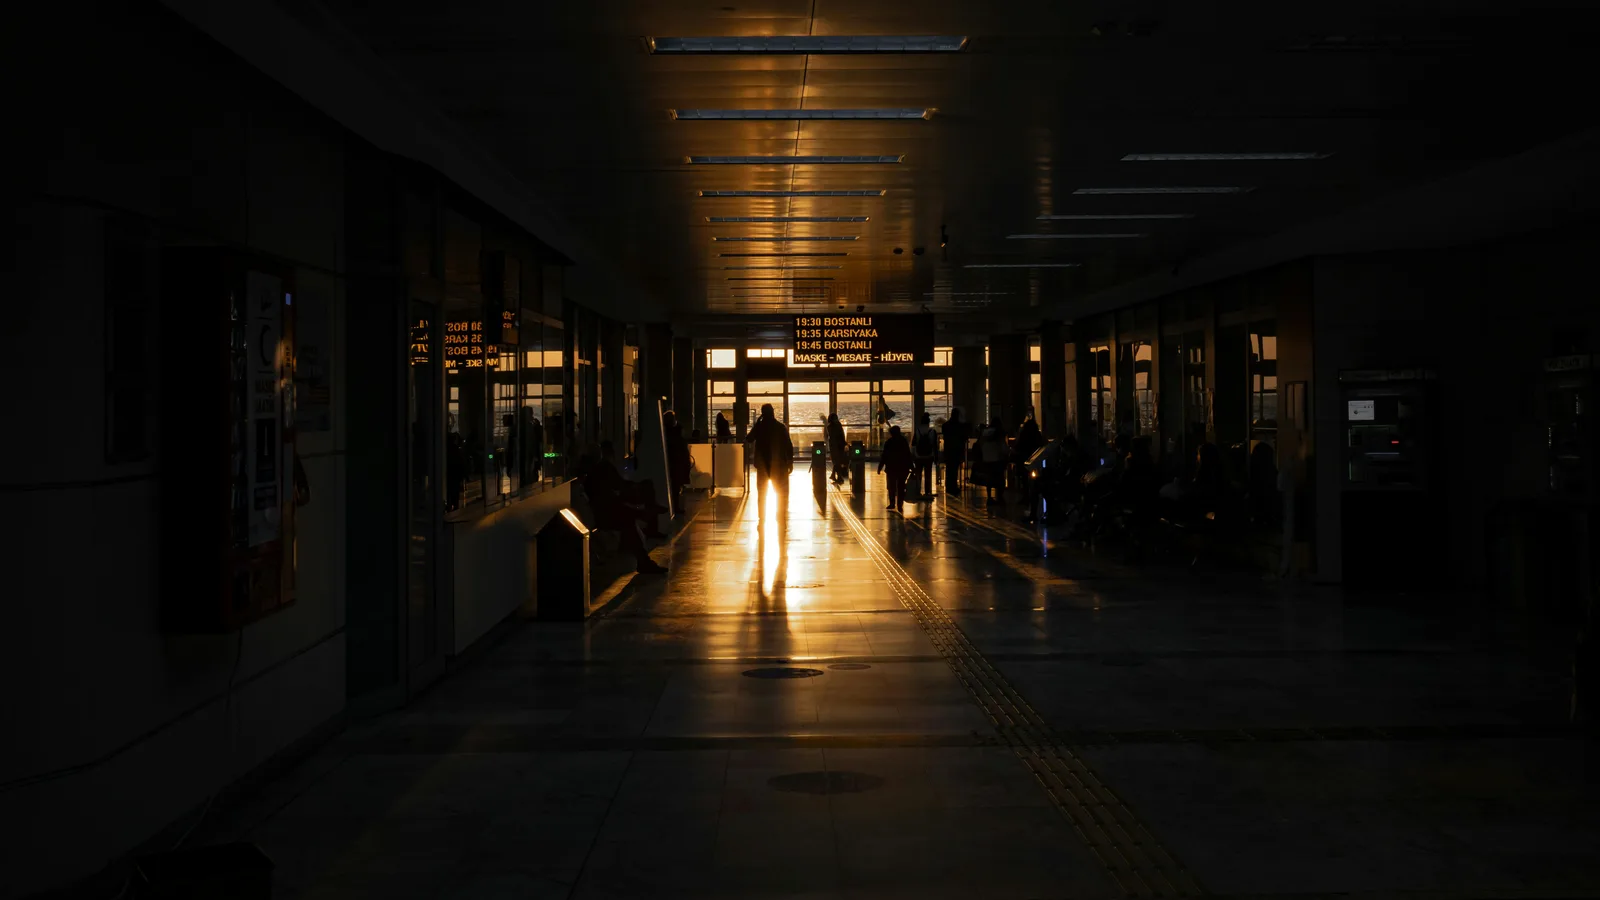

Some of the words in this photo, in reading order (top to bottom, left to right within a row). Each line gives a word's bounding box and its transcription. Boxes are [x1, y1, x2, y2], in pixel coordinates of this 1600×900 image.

[795, 317, 821, 327] 19:30
[824, 317, 872, 326] BOSTANLI
[795, 329, 821, 338] 19:35
[824, 329, 878, 338] KARSIYAKA
[796, 341, 821, 350] 19:45
[824, 341, 872, 350] BOSTANLI
[795, 354, 827, 362] MASKE
[836, 354, 872, 362] MESAFE
